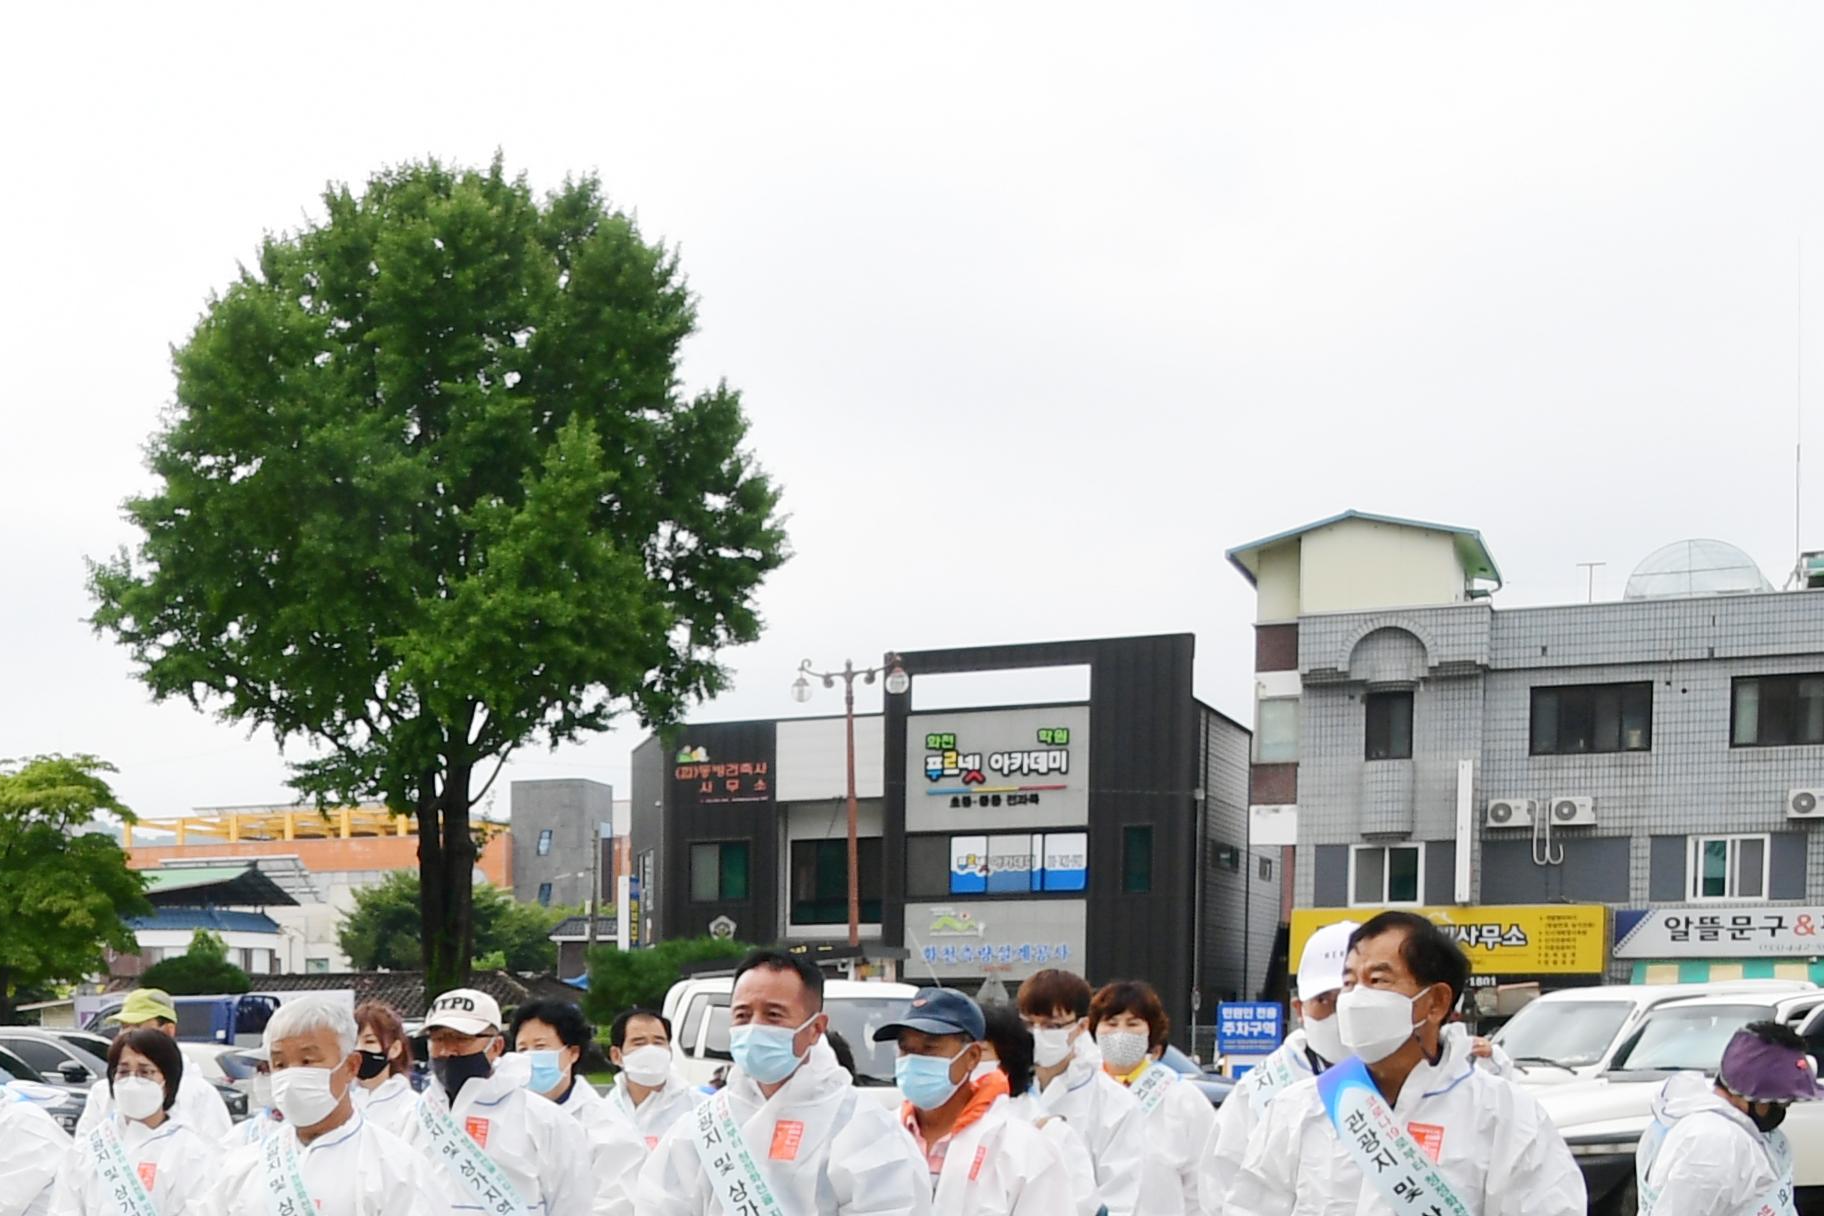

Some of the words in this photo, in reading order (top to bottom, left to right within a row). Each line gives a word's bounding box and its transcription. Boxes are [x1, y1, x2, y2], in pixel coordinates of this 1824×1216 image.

[926, 733, 956, 750] 화천
[1037, 728, 1070, 745] 학원
[925, 749, 986, 785] 푸르넷
[989, 750, 1069, 776] 아카데미
[1446, 923, 1529, 950] 사무소
[1664, 915, 1788, 942] 알뜰문구
[1793, 914, 1816, 936] &
[1222, 1021, 1277, 1036] 주차구역
[713, 1152, 736, 1177] 및
[1345, 1108, 1398, 1173] 관광지
[1393, 1176, 1424, 1204] 및
[459, 1158, 516, 1216] 상가지역
